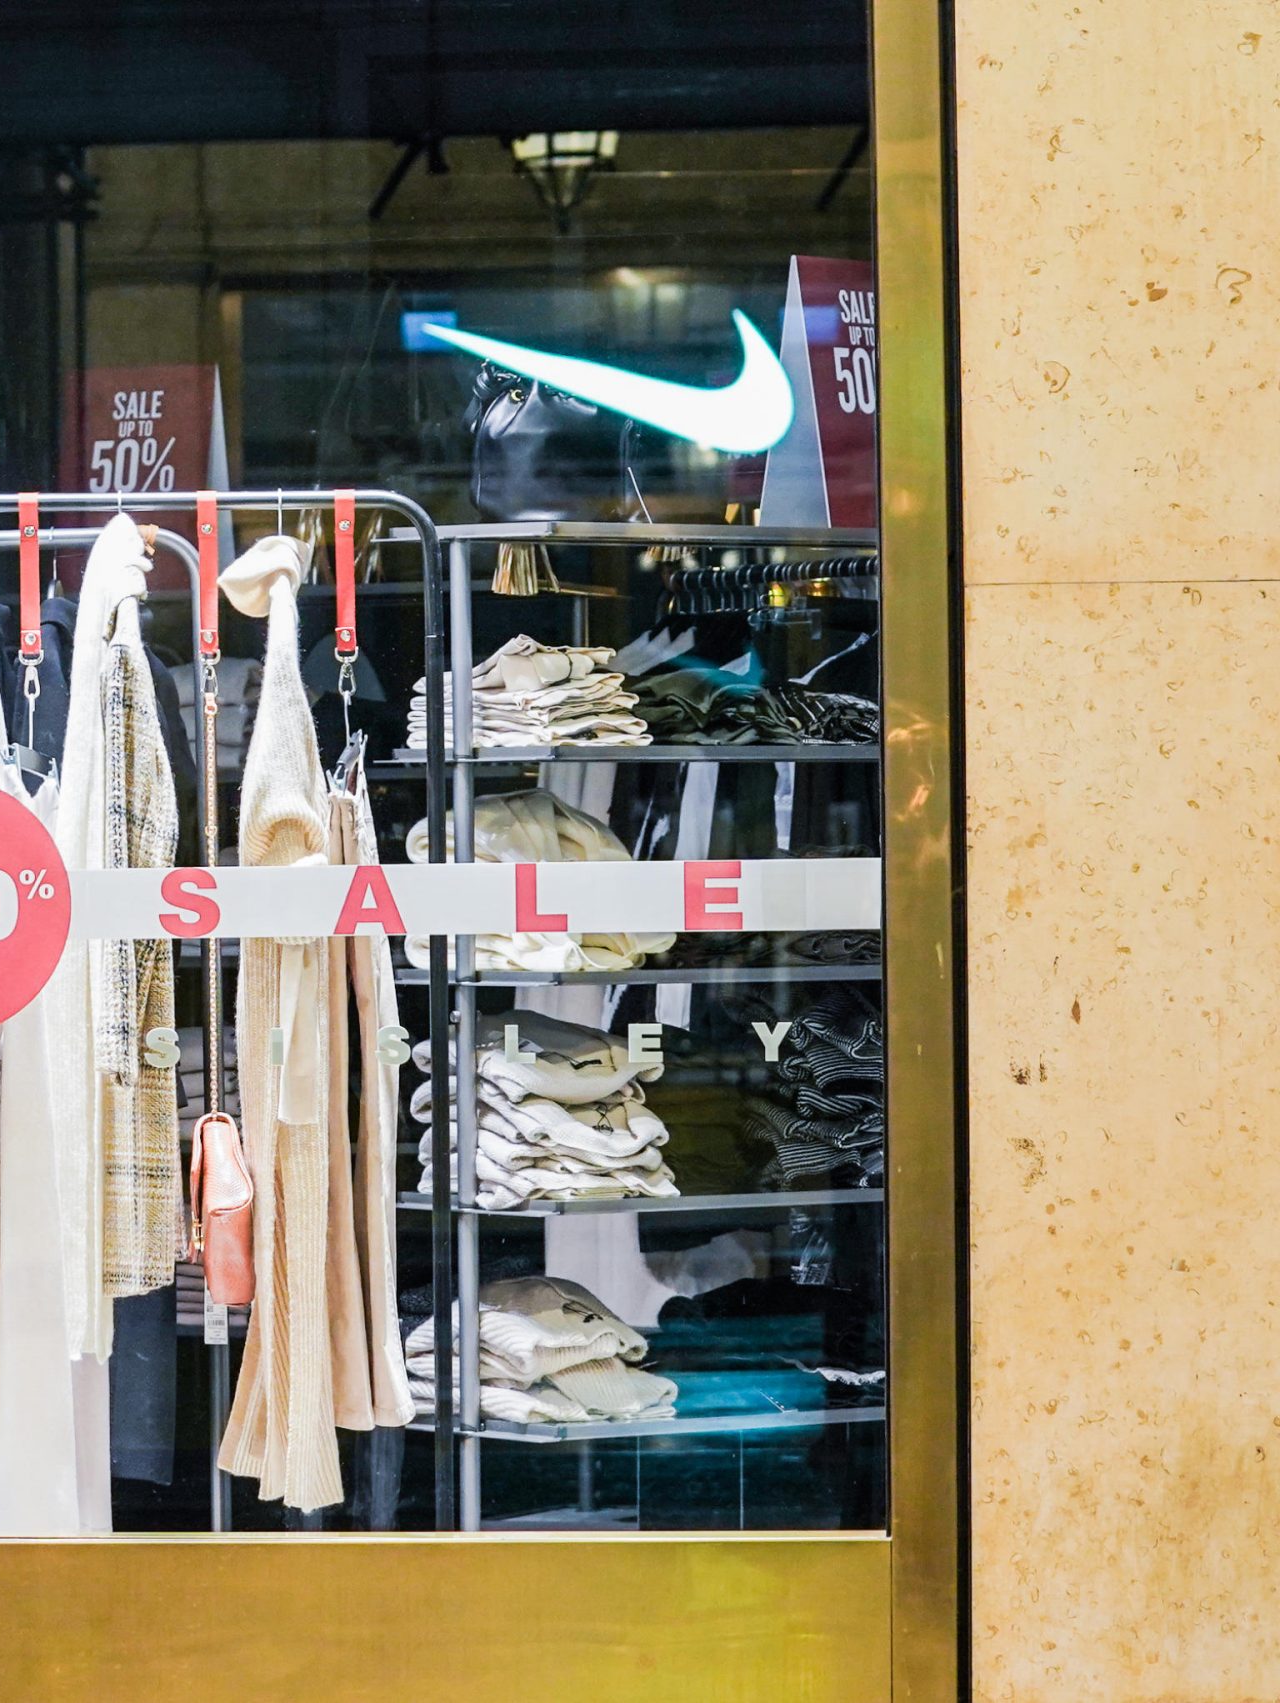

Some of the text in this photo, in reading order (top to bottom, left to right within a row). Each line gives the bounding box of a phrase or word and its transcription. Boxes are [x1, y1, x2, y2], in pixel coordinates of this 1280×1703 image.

[848, 325, 862, 346] UP
[833, 346, 877, 415] 50
[112, 390, 165, 420] SALE
[118, 420, 154, 437] UP TO
[89, 436, 176, 493] 50%
[158, 860, 744, 938] SALE
[144, 1021, 793, 1069] SISLEY
